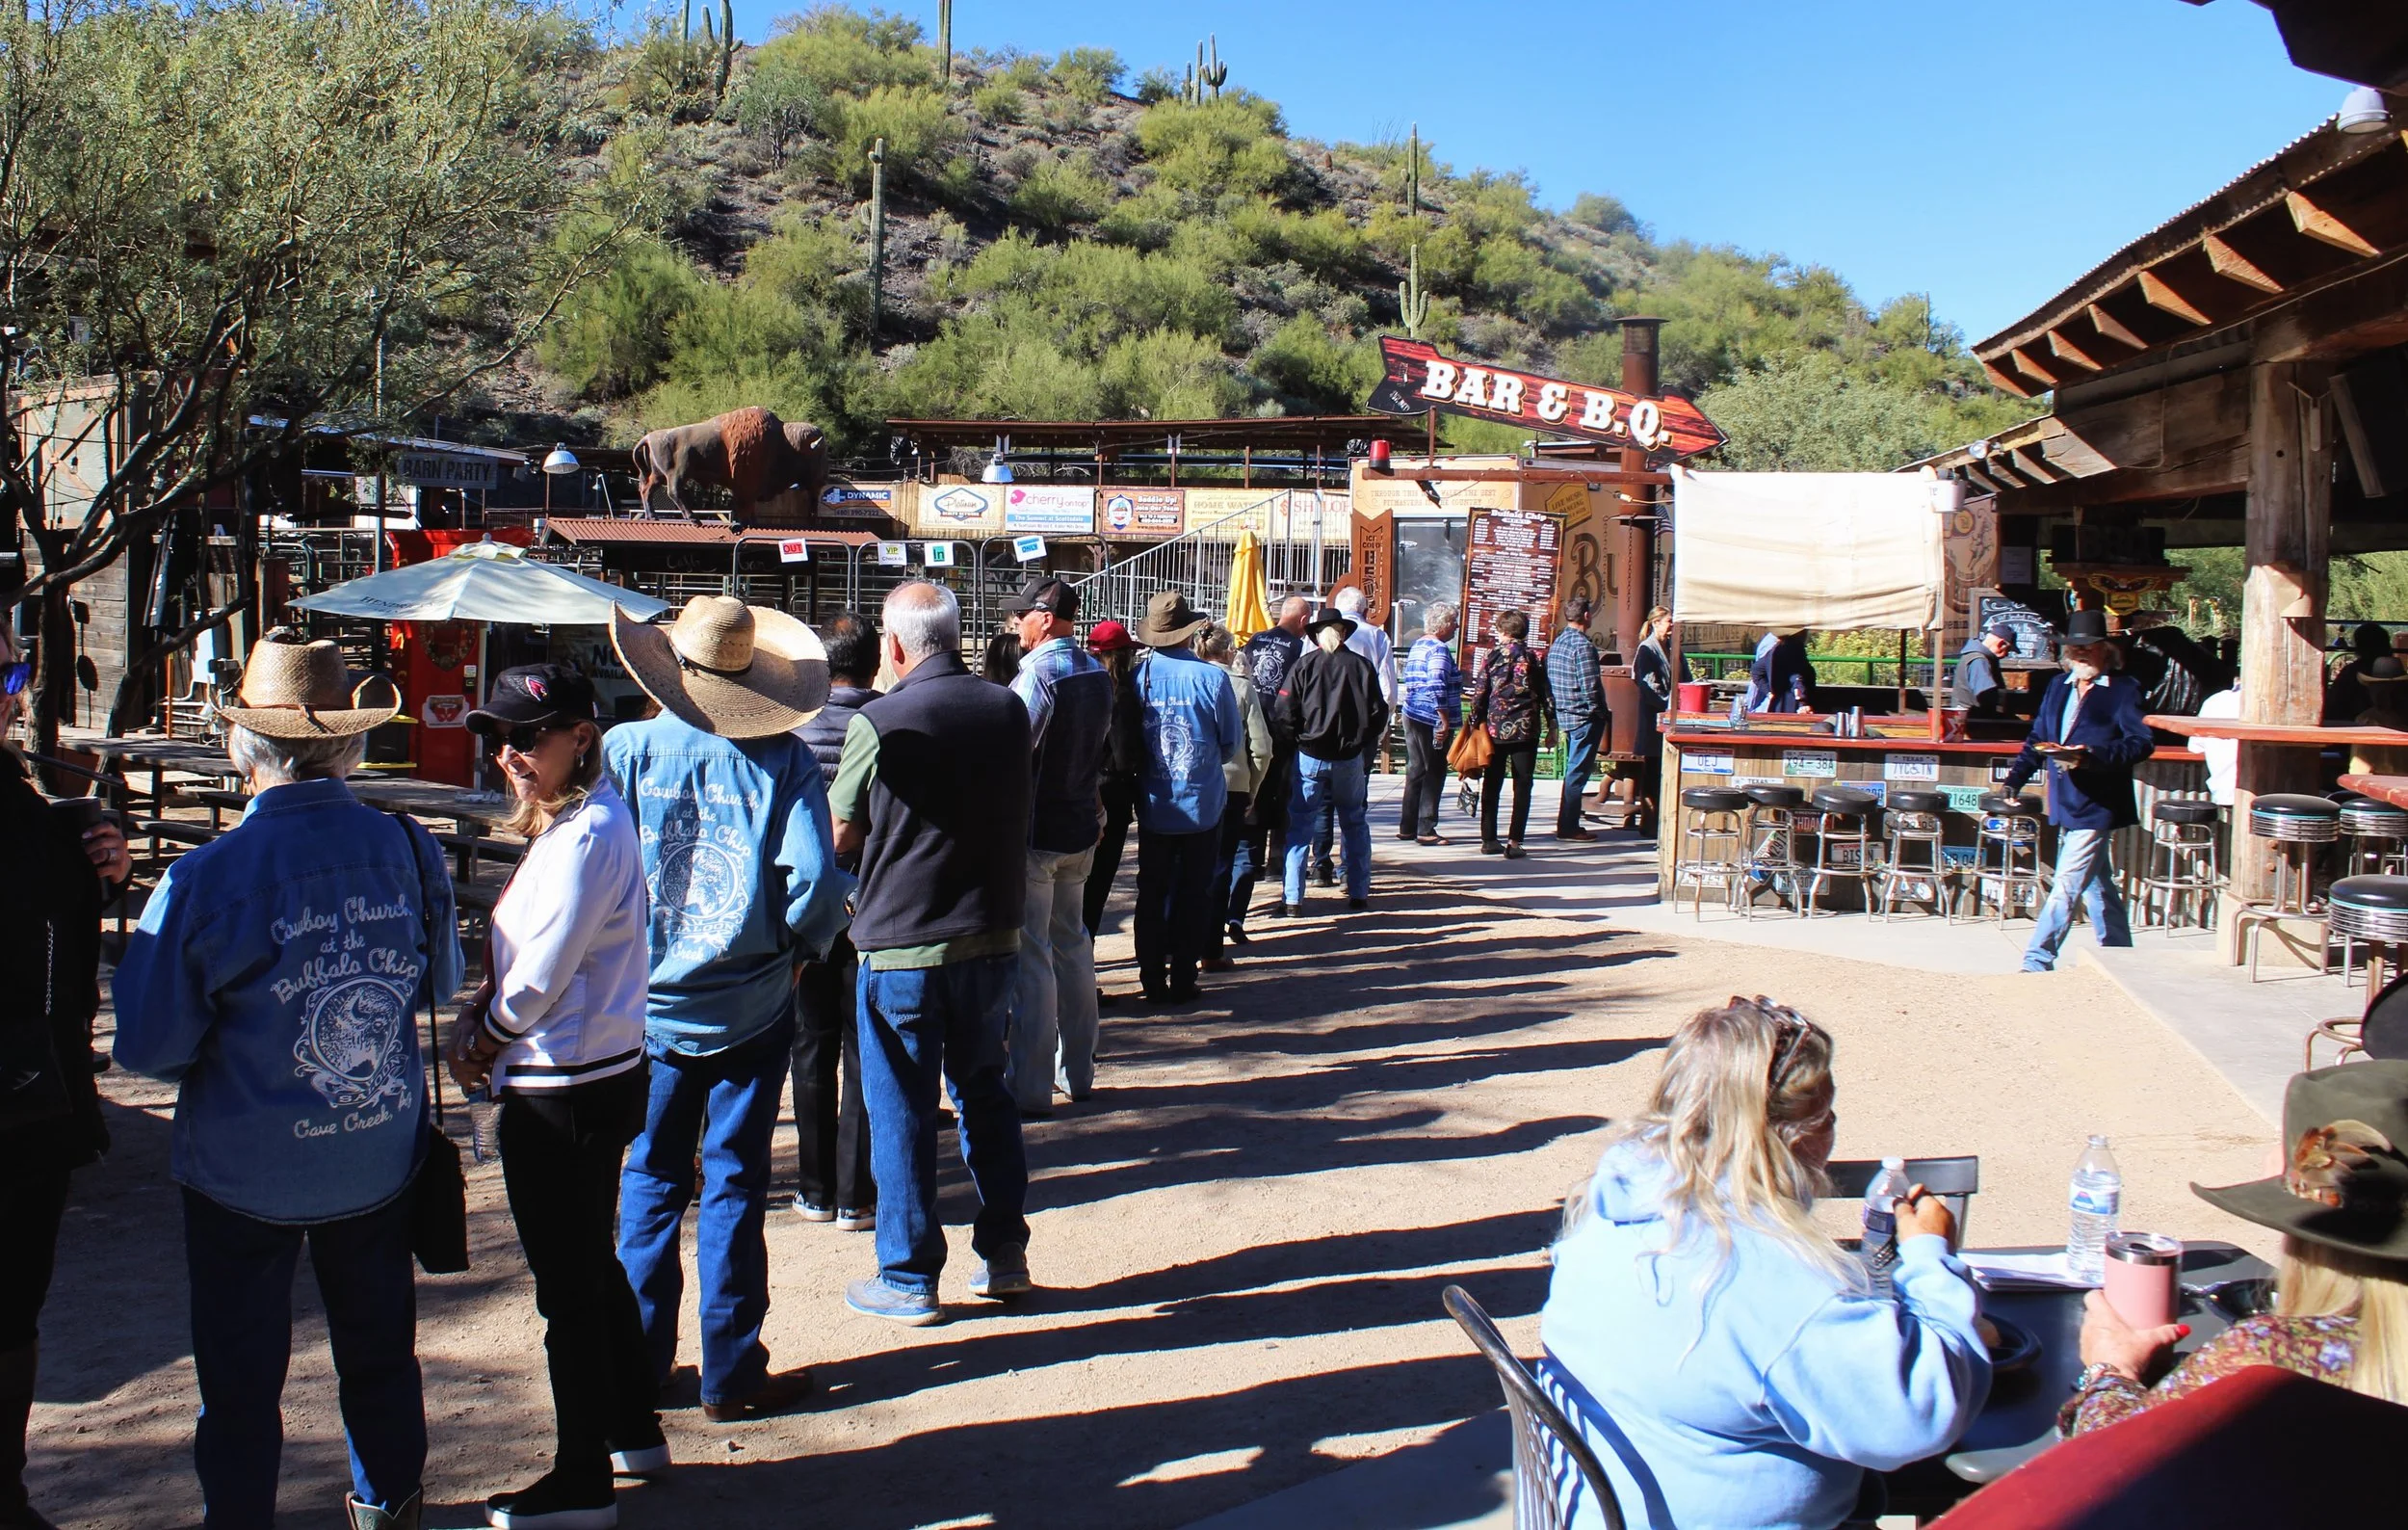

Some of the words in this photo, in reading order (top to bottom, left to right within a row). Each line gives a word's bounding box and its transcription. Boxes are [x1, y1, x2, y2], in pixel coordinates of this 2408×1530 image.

[1421, 360, 1526, 415] BAR
[1536, 382, 1570, 424] &
[404, 459, 440, 479] BARN
[446, 461, 490, 481] PARTY
[1026, 492, 1064, 508] cherry
[1074, 499, 1087, 508] top
[1165, 496, 1177, 505] Up!
[1525, 512, 1547, 521] Chip
[783, 542, 802, 554] OUT
[885, 545, 899, 555] VIP
[932, 546, 945, 562] In
[640, 777, 699, 805] Cowboy
[704, 782, 761, 809] Church
[681, 807, 694, 819] at
[698, 806, 717, 823] the
[640, 821, 708, 845] Buffalo
[714, 824, 752, 858] Chip
[1843, 849, 1873, 863] BISN
[270, 906, 339, 946] Cowboy
[344, 893, 413, 926] Church
[320, 939, 338, 955] at
[342, 929, 366, 950] the
[270, 951, 363, 1006] Buffalo
[367, 947, 419, 982] Chip
[293, 1118, 338, 1140] Cave
